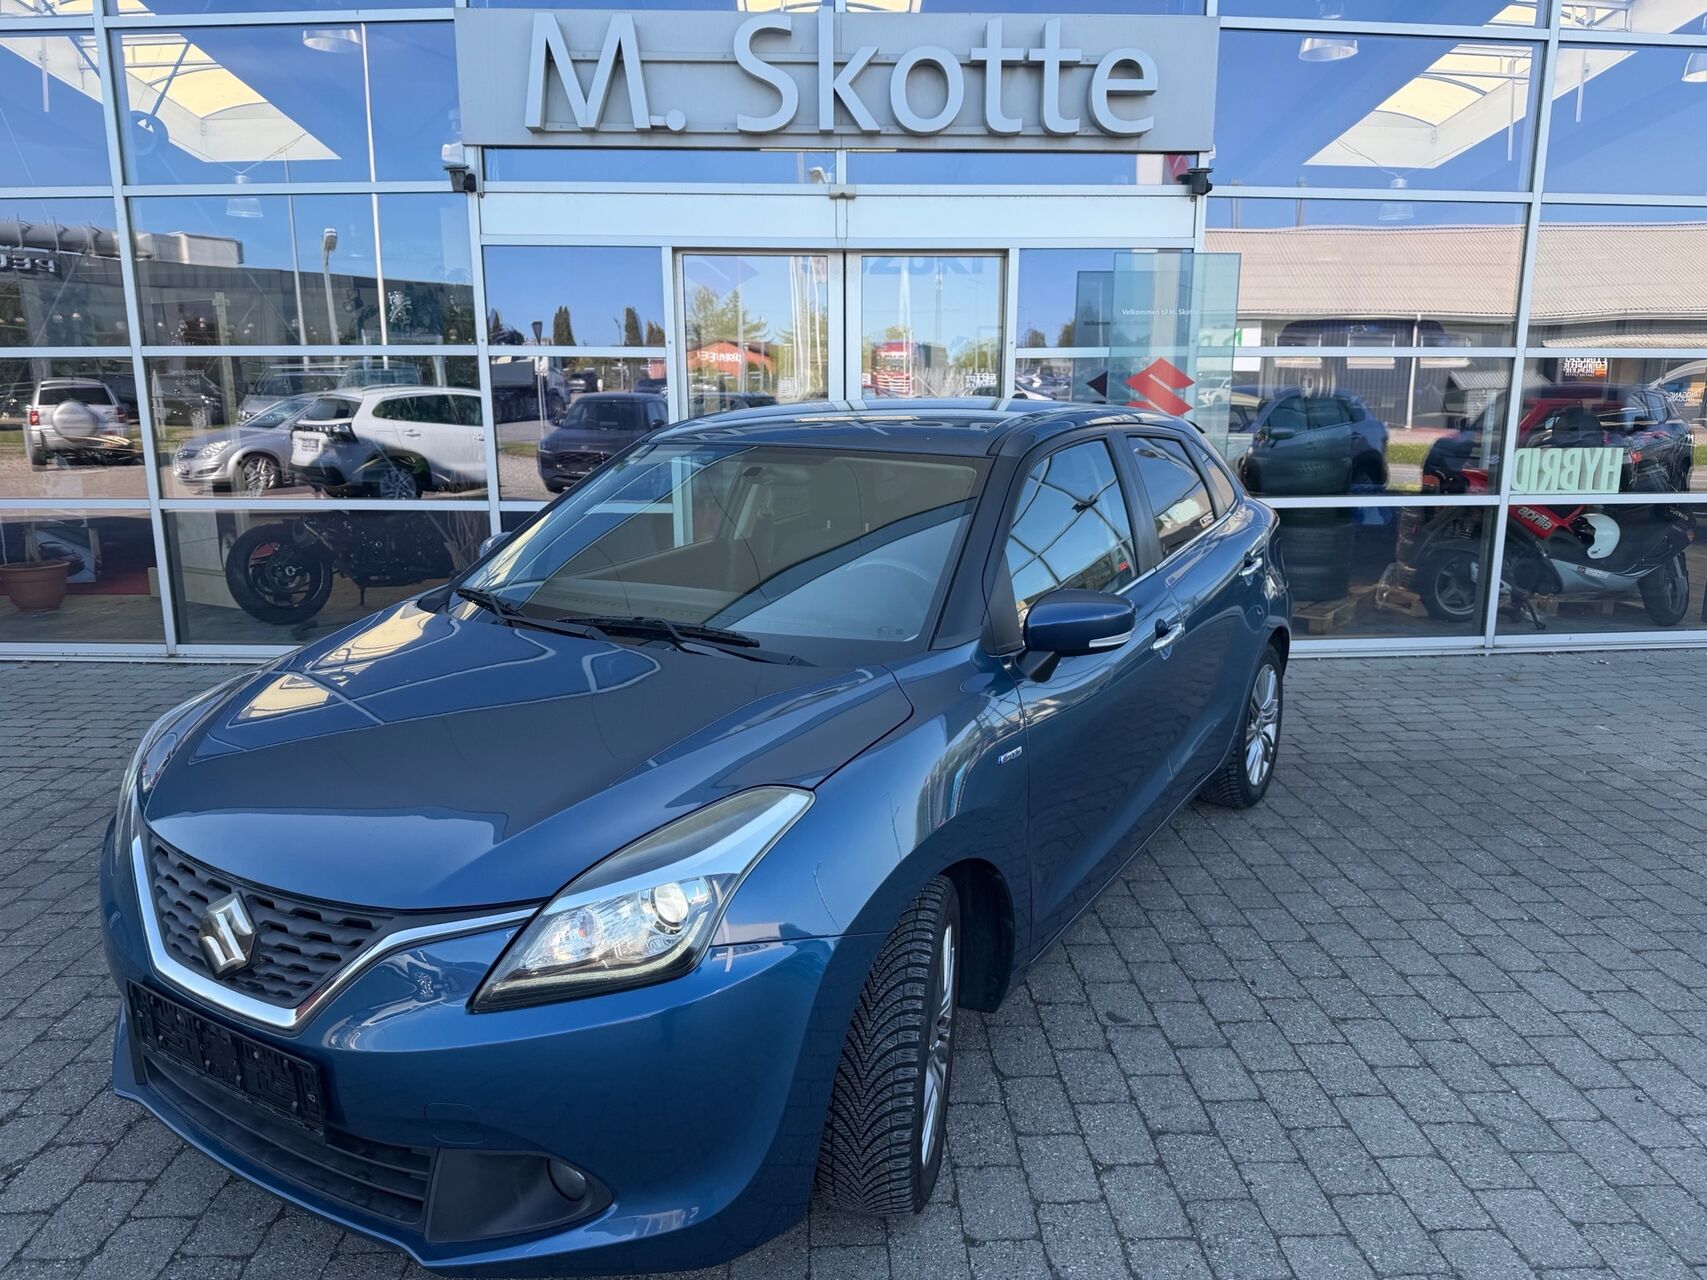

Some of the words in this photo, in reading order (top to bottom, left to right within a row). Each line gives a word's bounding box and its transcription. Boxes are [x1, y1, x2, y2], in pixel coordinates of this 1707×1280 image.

[525, 11, 688, 133] M.
[732, 6, 1159, 137] Skotte
[1121, 308, 1160, 316] Velkommen
[1161, 308, 1169, 316] til
[1517, 506, 1553, 530] aprilia
